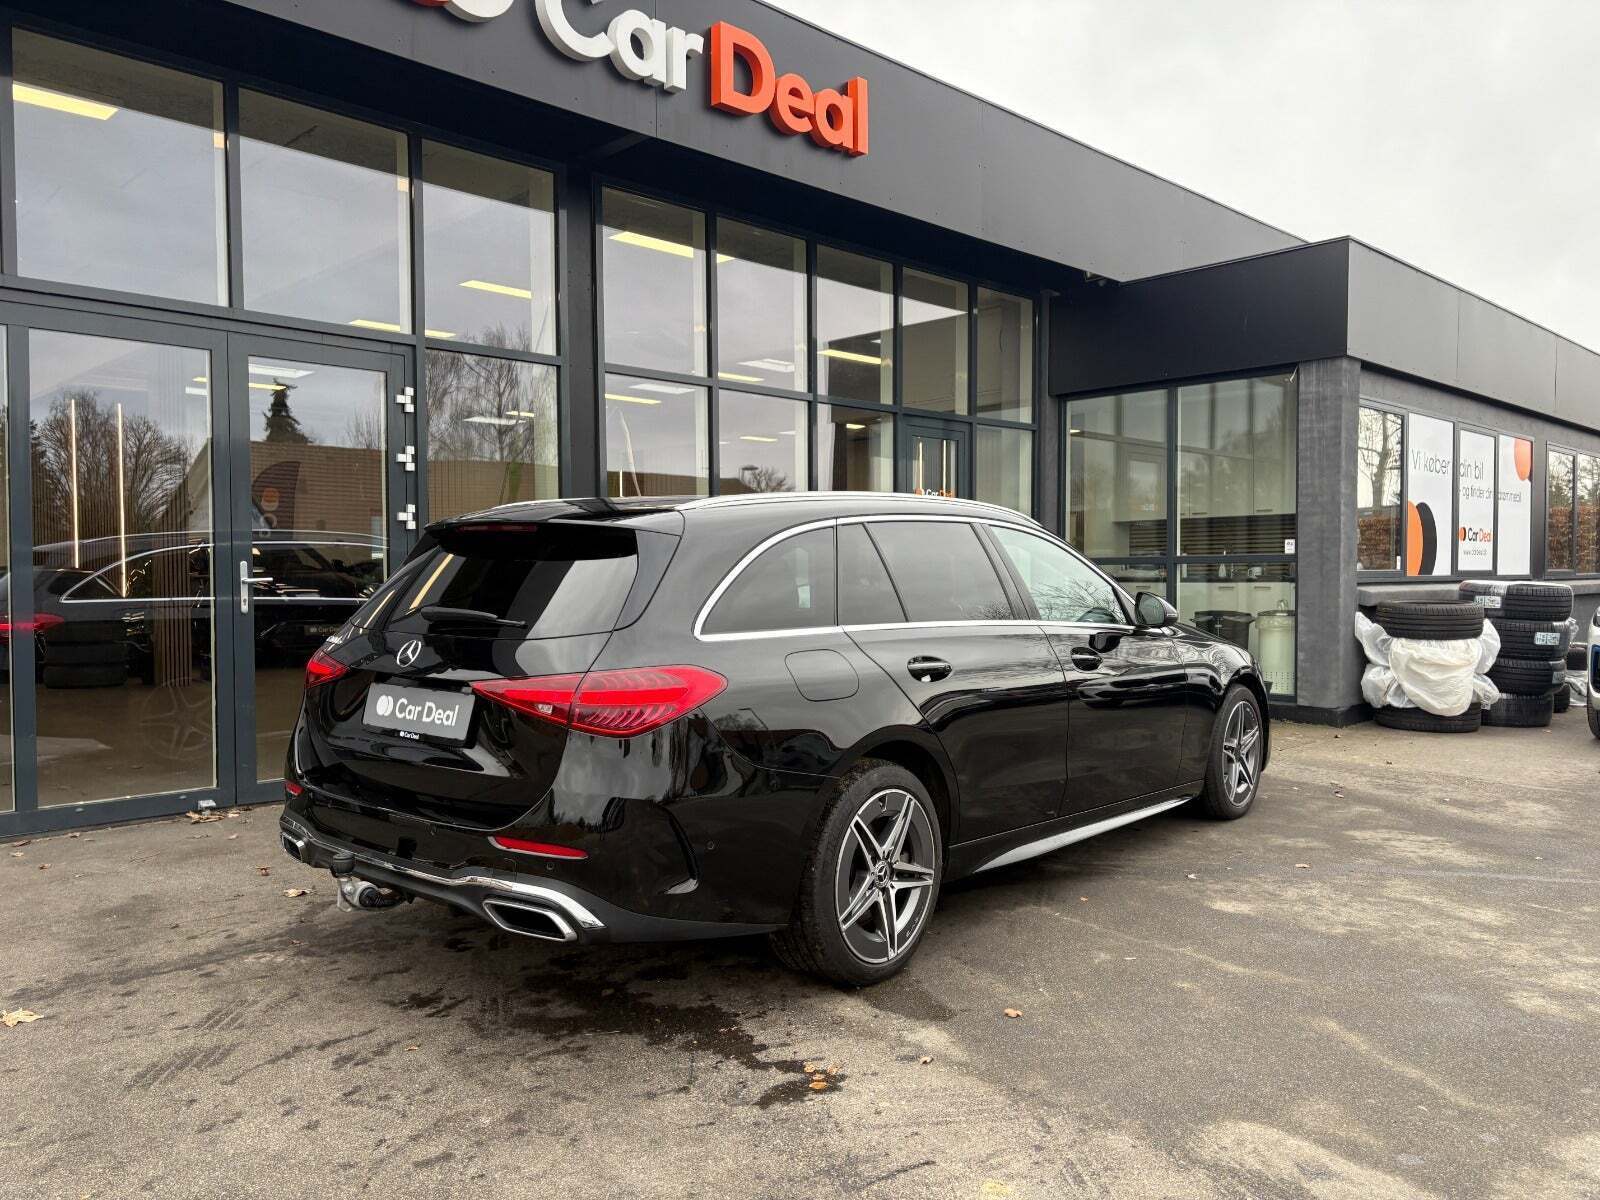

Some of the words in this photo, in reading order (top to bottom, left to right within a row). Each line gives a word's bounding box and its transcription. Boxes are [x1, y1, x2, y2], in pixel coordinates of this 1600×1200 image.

[535, 0, 705, 94] Car
[710, 20, 868, 157] Deal
[1411, 448, 1421, 471] Vi
[1423, 452, 1451, 475] køber
[1474, 459, 1484, 481] bil
[1468, 528, 1479, 541] Car
[395, 697, 422, 721] Car
[422, 701, 460, 727] Deal
